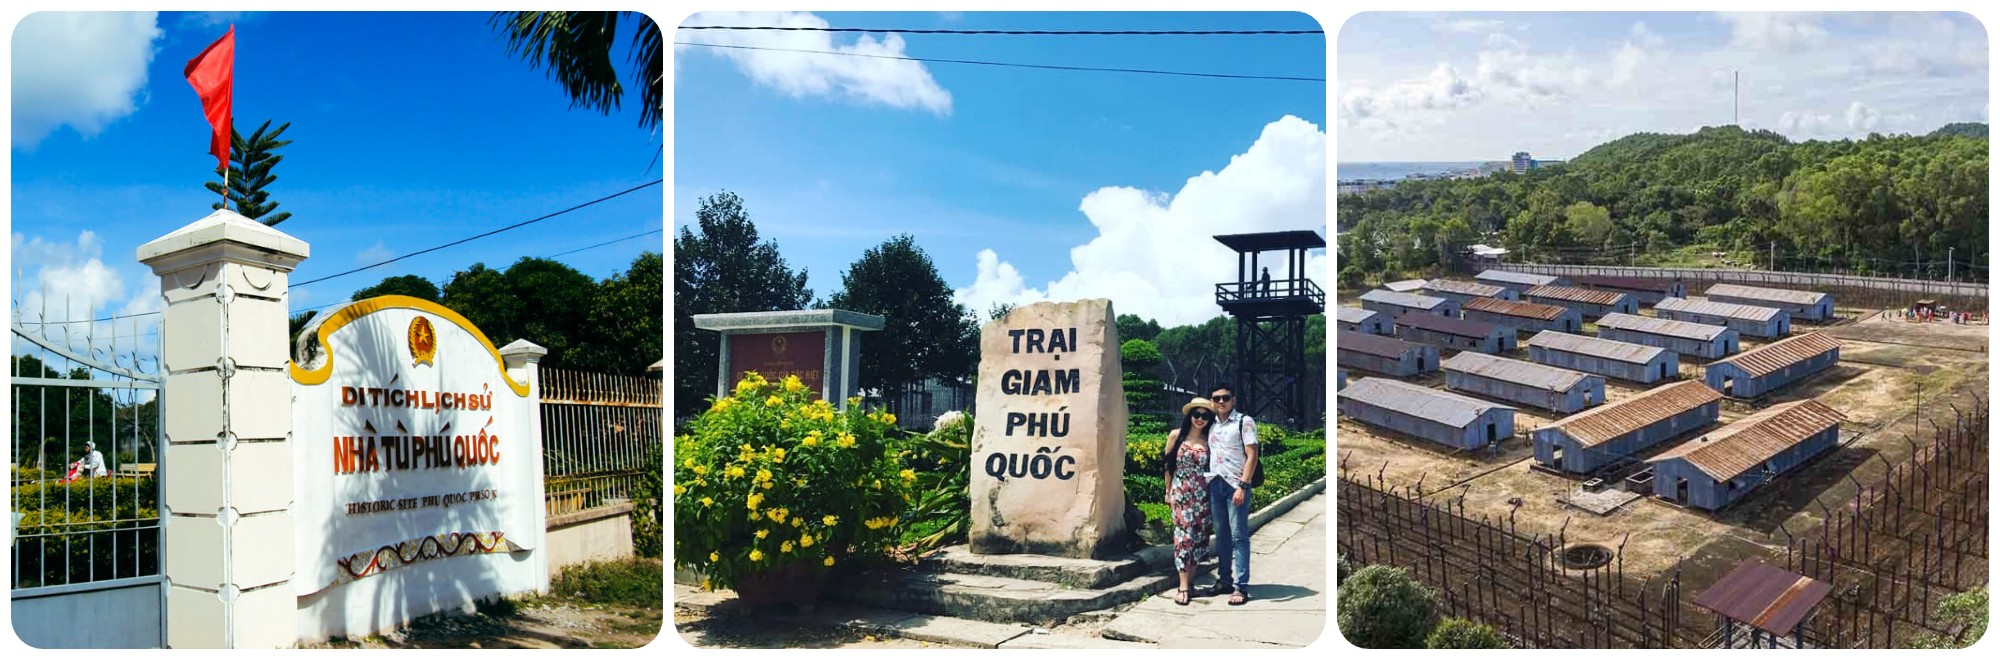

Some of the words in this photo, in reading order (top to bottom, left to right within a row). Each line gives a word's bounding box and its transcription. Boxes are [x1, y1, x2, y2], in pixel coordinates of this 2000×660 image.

[1008, 328, 1077, 361] TRẠI
[341, 385, 365, 406] DI
[367, 373, 419, 408] TÍCH
[421, 391, 466, 414] LỊCH
[468, 383, 493, 410] SỬ
[1001, 368, 1080, 396] GIAM
[1005, 406, 1071, 437] PHÚ
[333, 419, 380, 474] NHÀ
[380, 419, 409, 471] TÙ
[412, 421, 452, 469] PHÚ
[453, 415, 500, 469] QUỐC
[985, 446, 1076, 482] QUỐC
[346, 499, 396, 515] HISTORIC
[397, 497, 418, 509] SITE
[422, 495, 441, 508] PHU
[443, 492, 467, 507] QUOC
